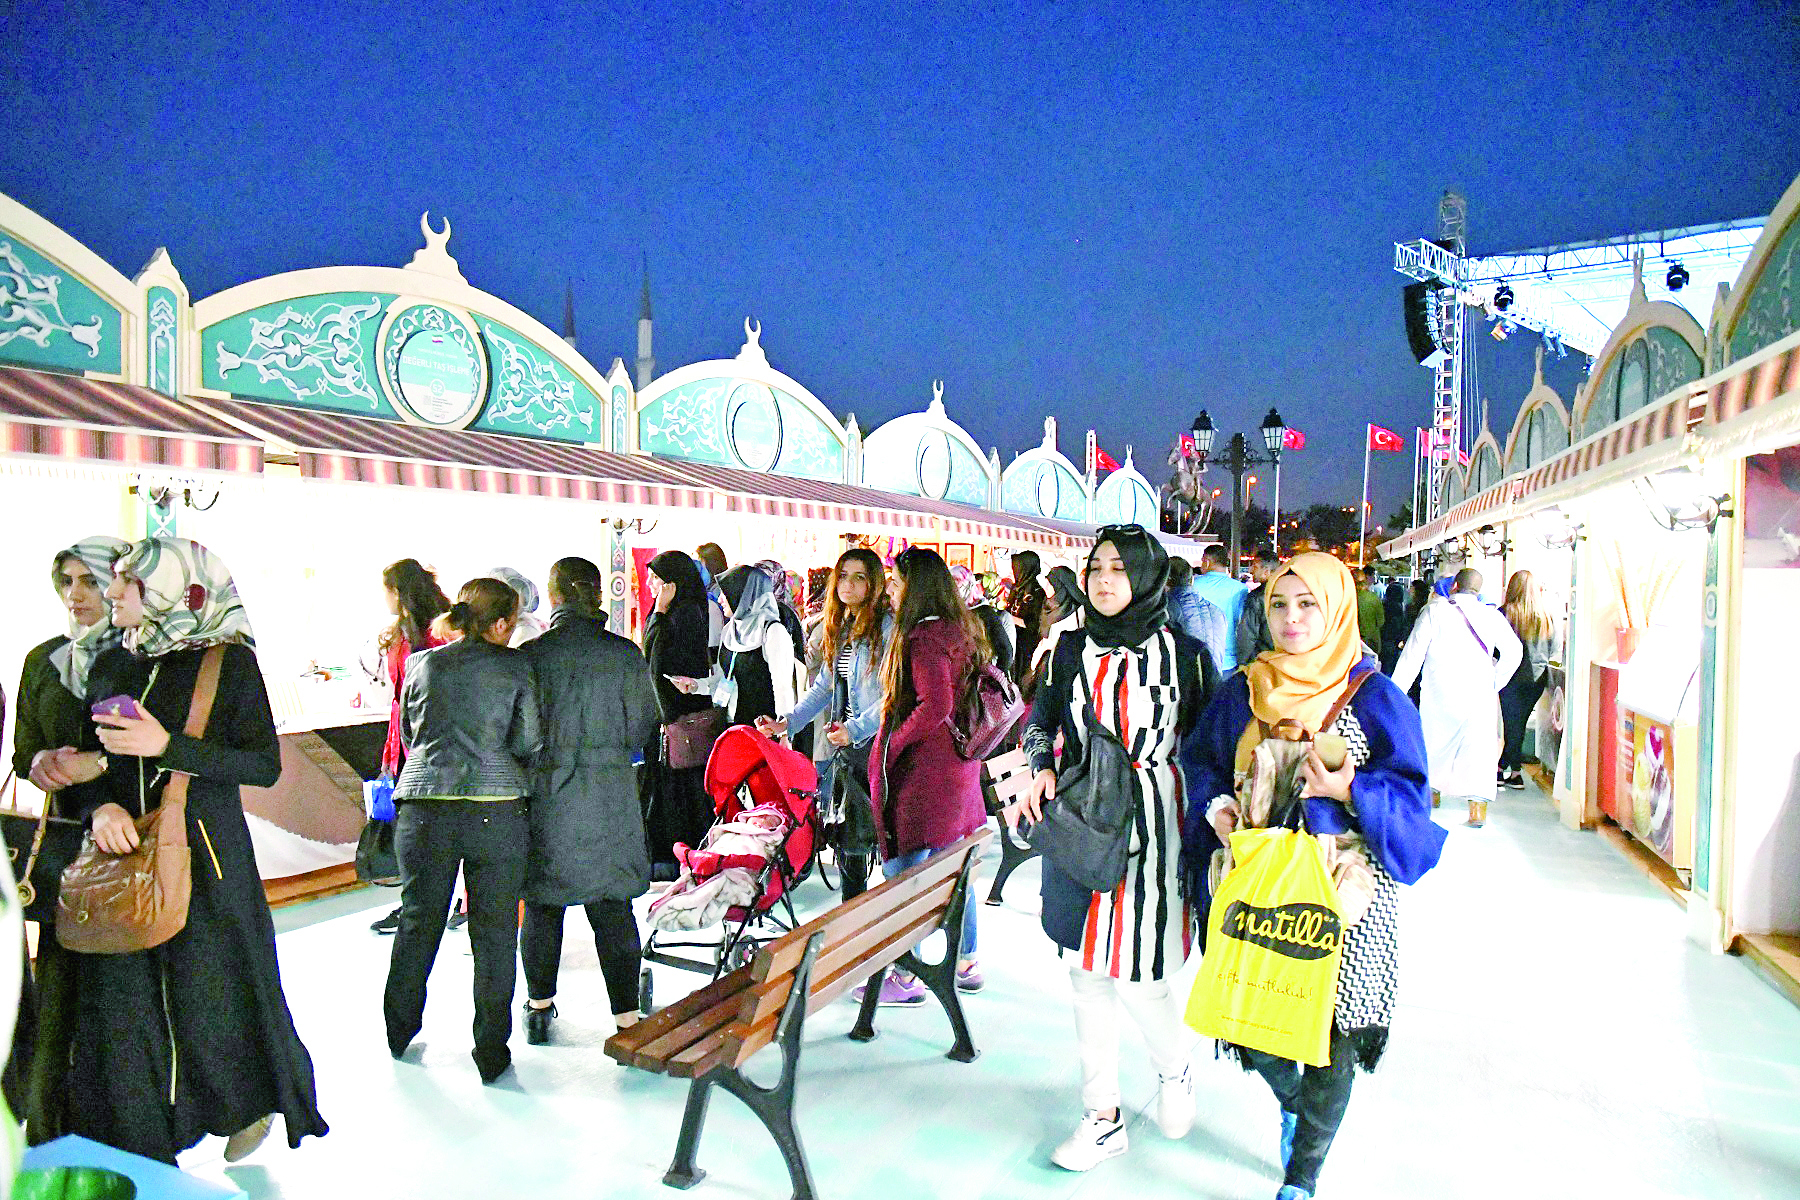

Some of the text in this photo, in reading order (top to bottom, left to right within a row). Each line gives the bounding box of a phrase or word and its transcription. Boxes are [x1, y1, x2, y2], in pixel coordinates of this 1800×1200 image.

[402, 355, 432, 368] DEĞERLİ
[433, 361, 446, 372] TAŞ
[432, 384, 443, 393] 52
